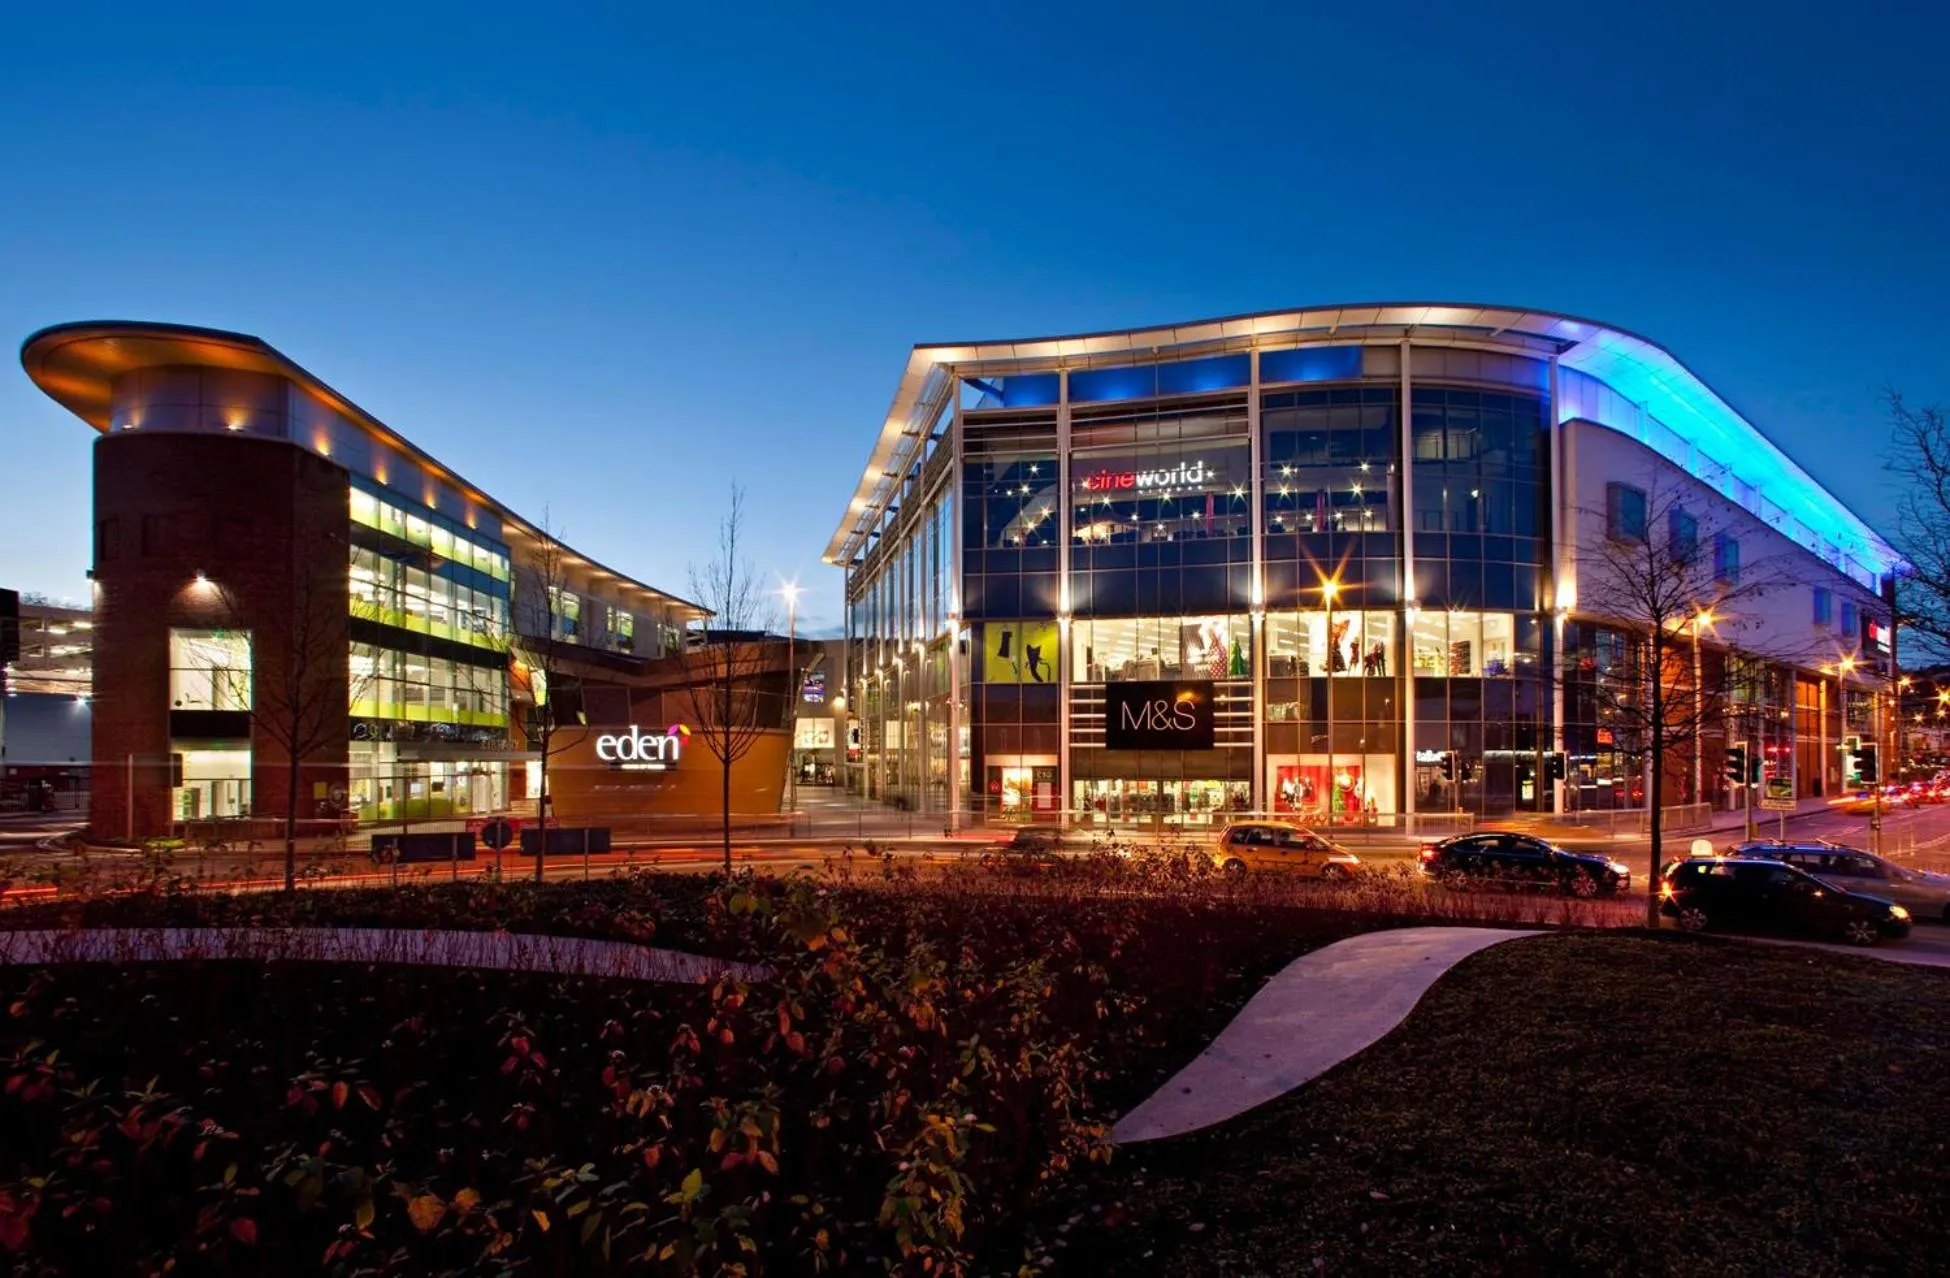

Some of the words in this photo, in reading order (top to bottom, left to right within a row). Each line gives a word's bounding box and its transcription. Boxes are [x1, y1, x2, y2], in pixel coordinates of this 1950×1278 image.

[1086, 460, 1203, 490] cineworld
[1121, 699, 1196, 731] M&S
[596, 724, 679, 760] eden
